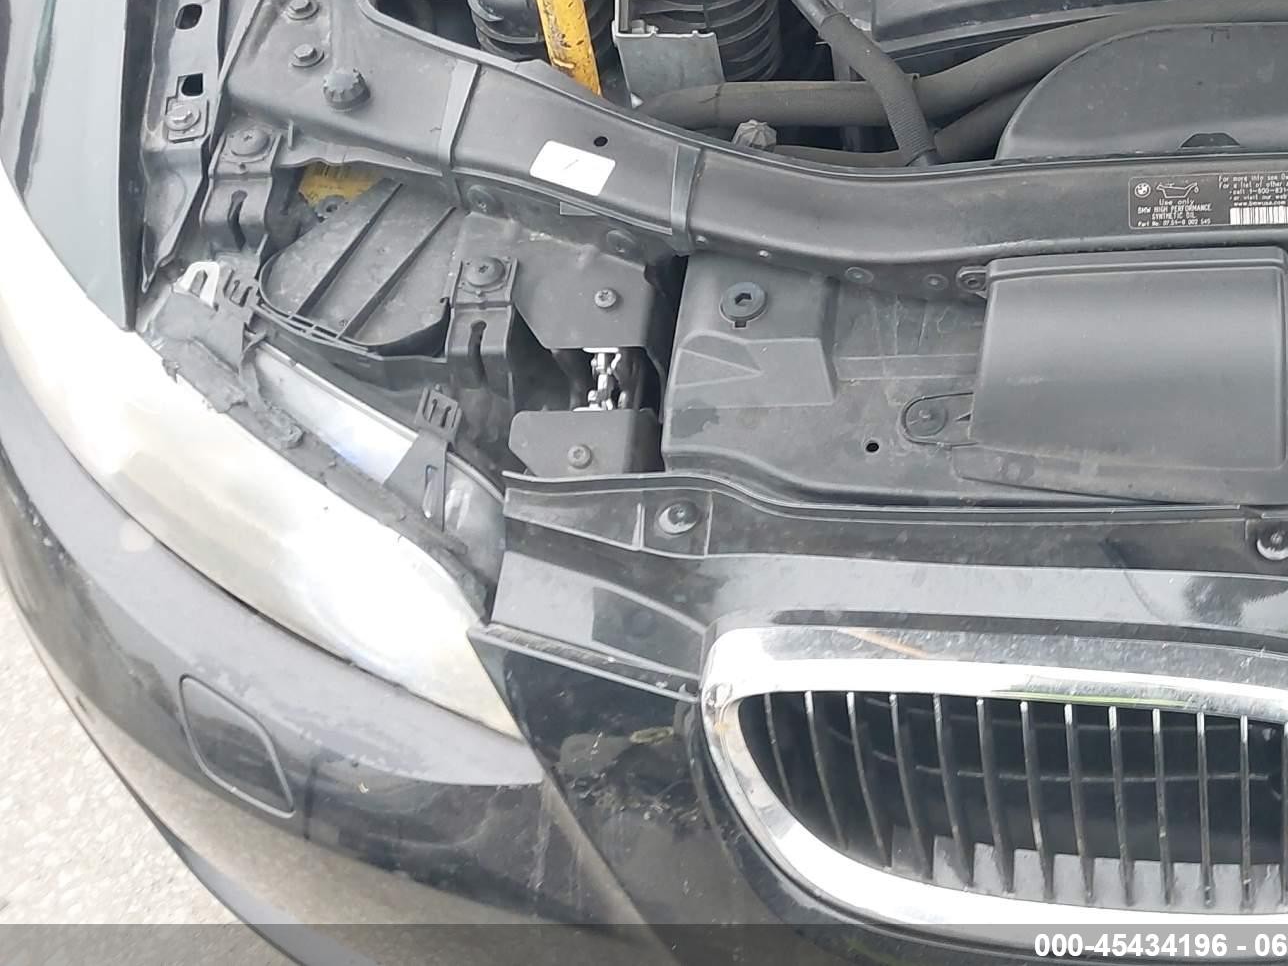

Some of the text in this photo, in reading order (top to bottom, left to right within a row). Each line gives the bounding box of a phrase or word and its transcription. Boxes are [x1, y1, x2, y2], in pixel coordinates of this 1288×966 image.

[1177, 197, 1194, 205] only
[1138, 206, 1151, 214] BMW
[1170, 203, 1212, 212] PERFORMANCE
[1152, 212, 1183, 220] SYNTHETIC
